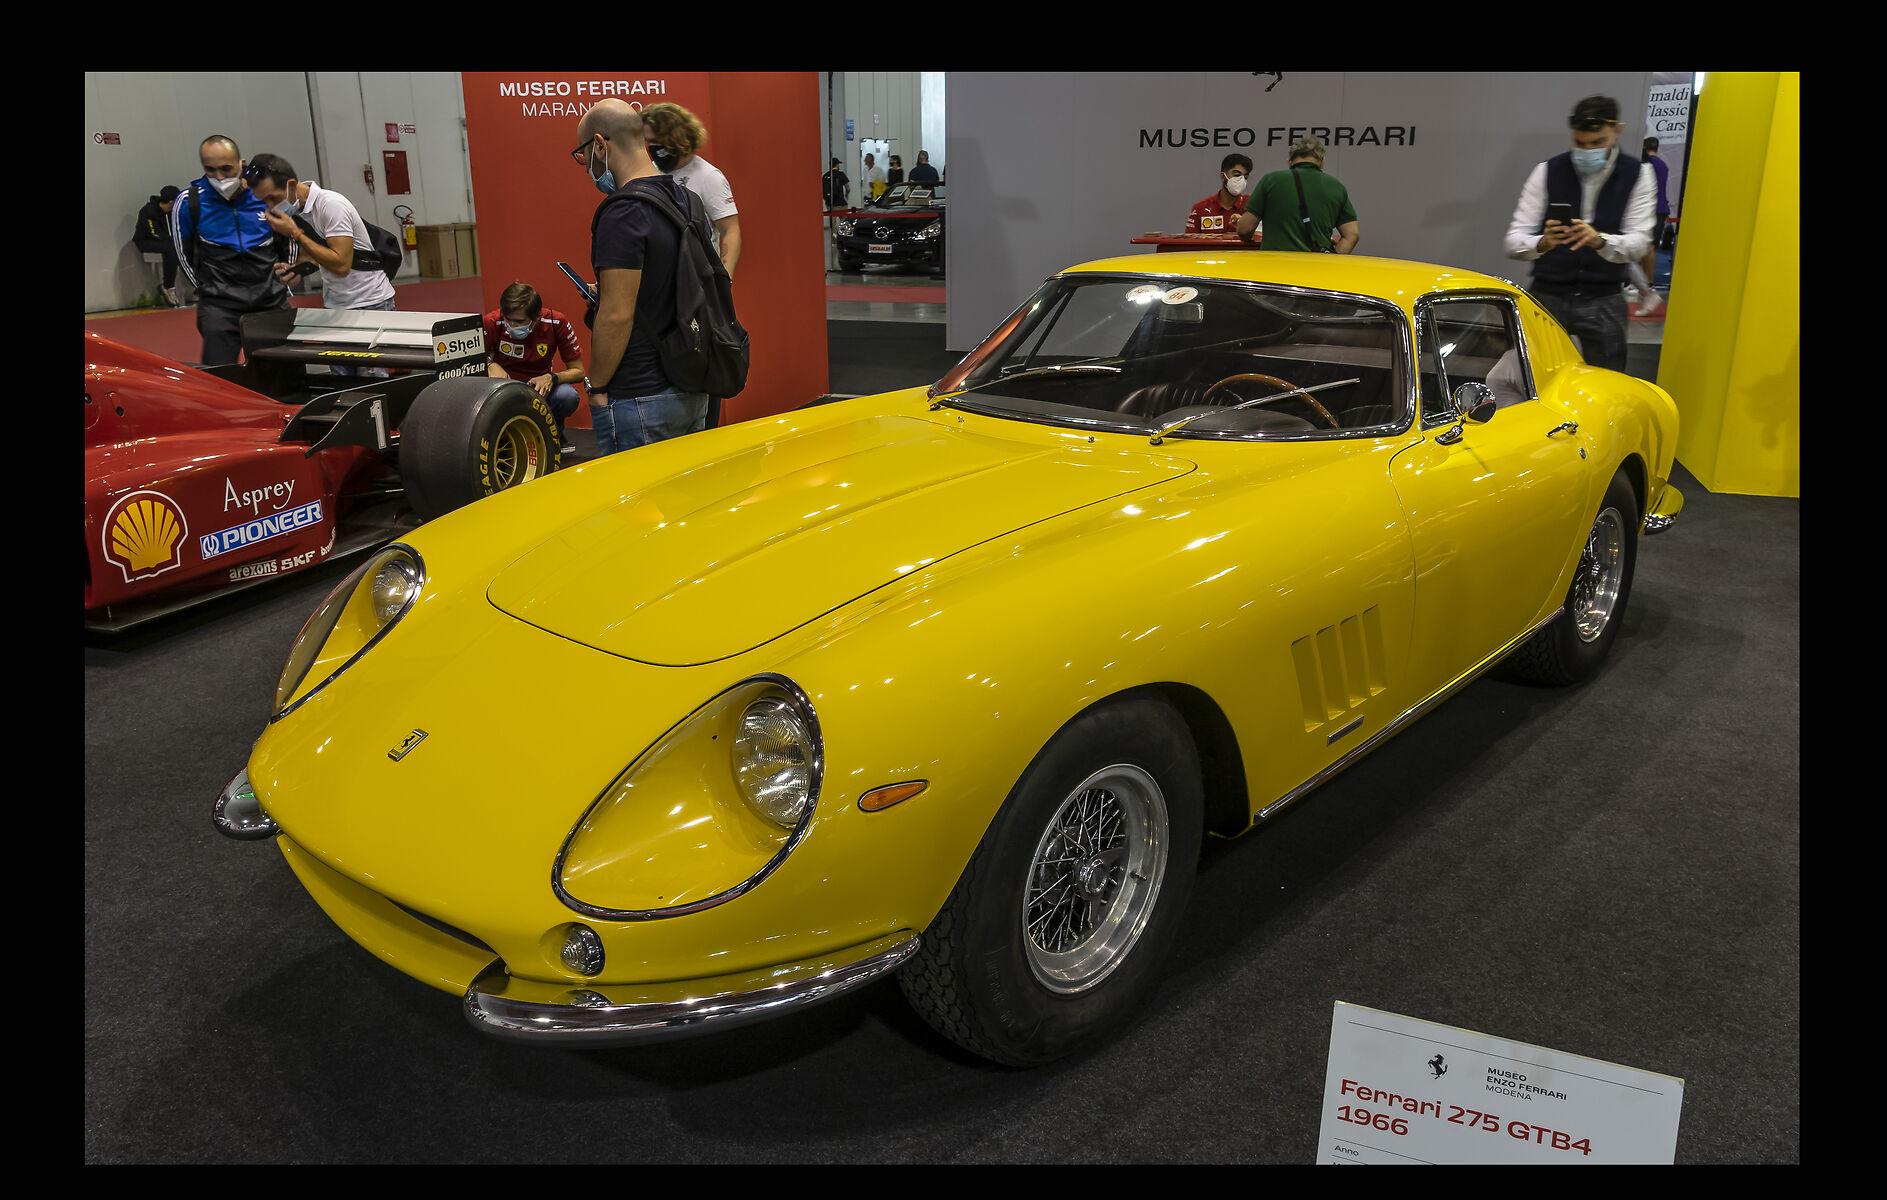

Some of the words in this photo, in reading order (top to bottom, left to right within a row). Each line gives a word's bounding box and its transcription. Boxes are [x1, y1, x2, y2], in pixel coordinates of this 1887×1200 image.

[500, 82, 571, 97] MUSEO
[577, 80, 666, 96] FERRARI
[1655, 119, 1687, 132] Cars
[1139, 127, 1256, 148] MUSEO
[1267, 126, 1416, 147] FERRARI
[449, 336, 481, 353] Shell
[370, 400, 387, 449] 1
[223, 476, 296, 516] Asprey
[222, 502, 322, 549] PIONEER
[229, 560, 278, 580] arexons
[281, 551, 316, 571] SKF
[1487, 1067, 1527, 1082] MUSEO
[1485, 1084, 1533, 1101] MODENA
[1486, 1076, 1516, 1088] ENZO
[1518, 1083, 1567, 1101] FERRARI
[1337, 1105, 1409, 1136] 1966
[1341, 1079, 1442, 1118] Ferrari
[1447, 1105, 1500, 1132] 275
[1507, 1121, 1592, 1156] GTB4
[1334, 1145, 1359, 1157] Anno
